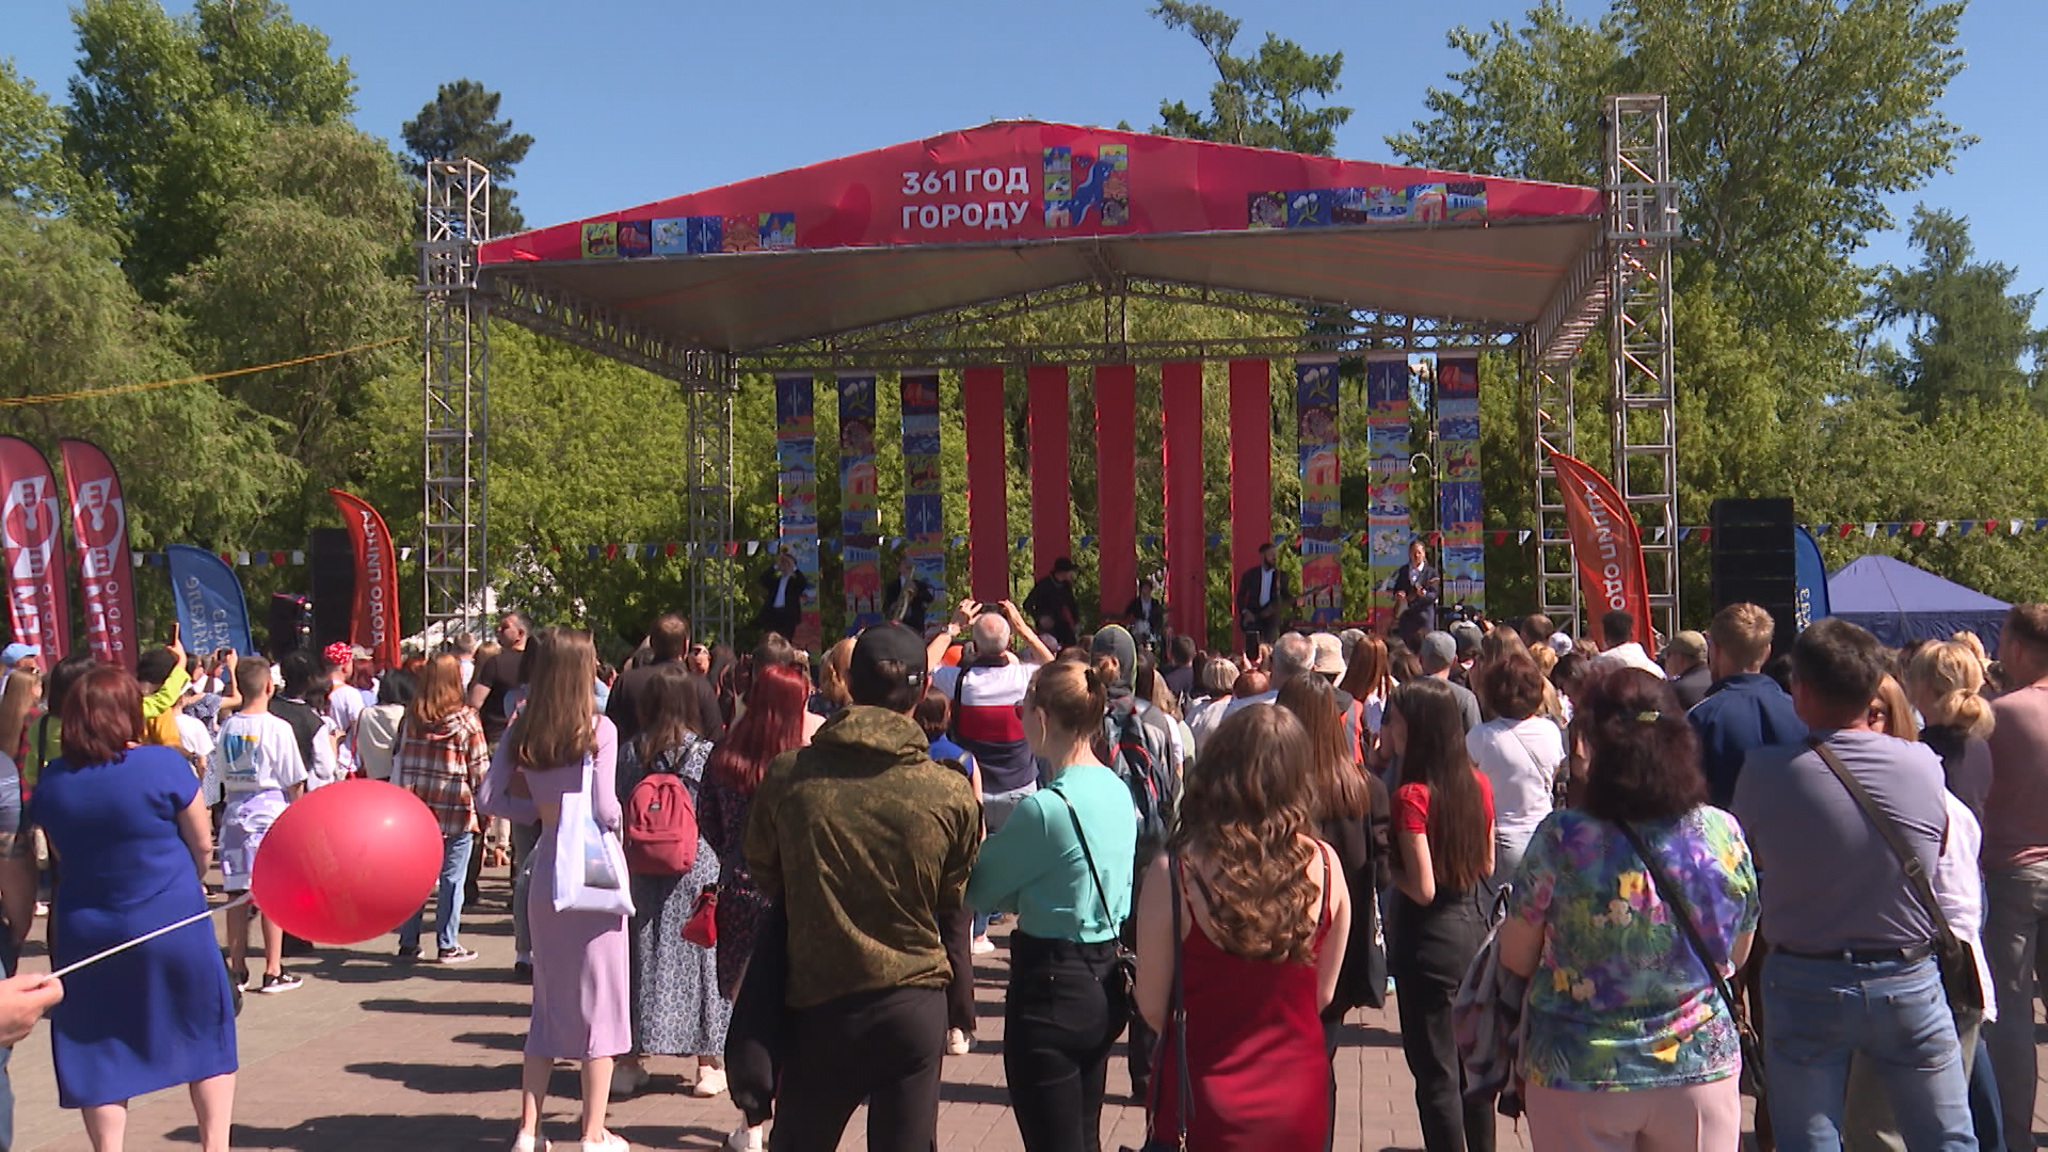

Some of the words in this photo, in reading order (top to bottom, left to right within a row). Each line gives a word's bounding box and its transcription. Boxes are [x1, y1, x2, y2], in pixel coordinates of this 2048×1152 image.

[902, 169, 957, 195] 361
[965, 166, 1029, 194] ГОД
[902, 200, 1029, 230] ГОРОДУ
